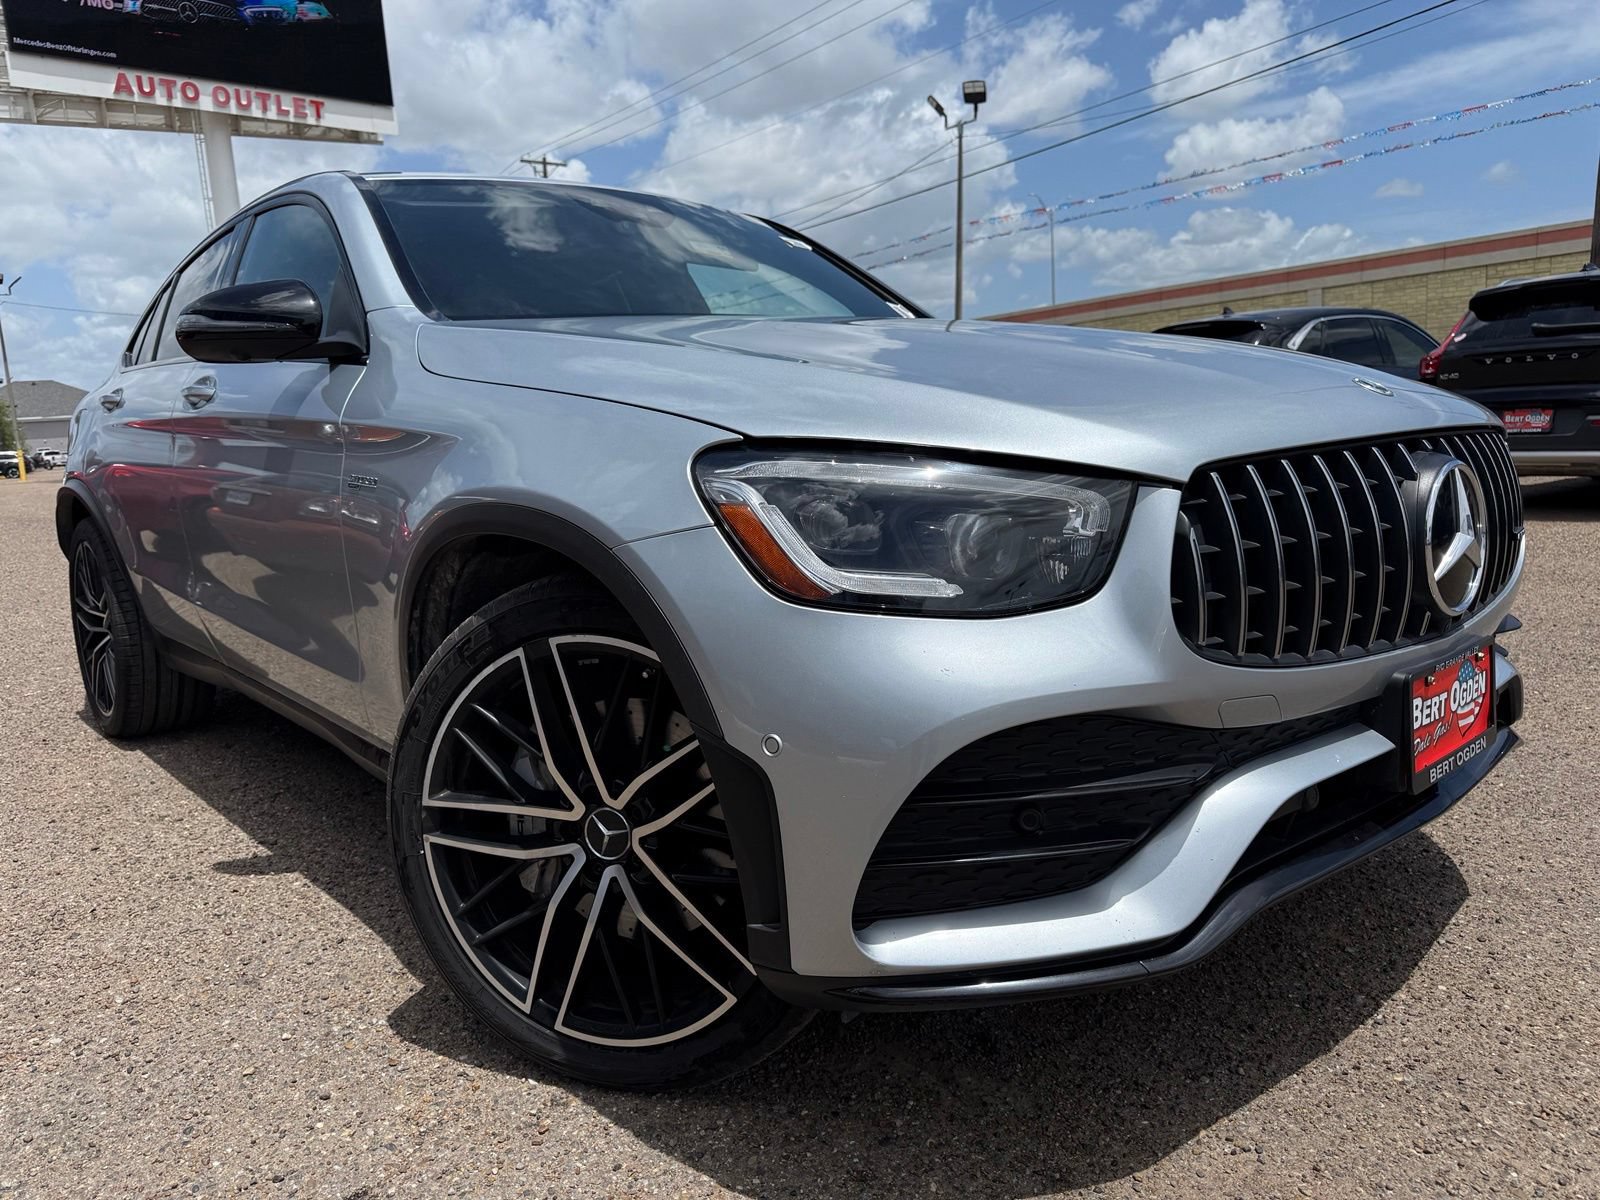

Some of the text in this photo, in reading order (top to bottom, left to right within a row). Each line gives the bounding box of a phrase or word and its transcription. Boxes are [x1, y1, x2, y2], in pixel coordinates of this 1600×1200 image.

[113, 72, 326, 121] AUTO OUTLET
[1485, 353, 1579, 364] VOLVO
[1505, 414, 1551, 423] BERT OGDEN
[1413, 671, 1486, 730] BERT OGDEN
[1429, 735, 1487, 783] BERT OGDEN
